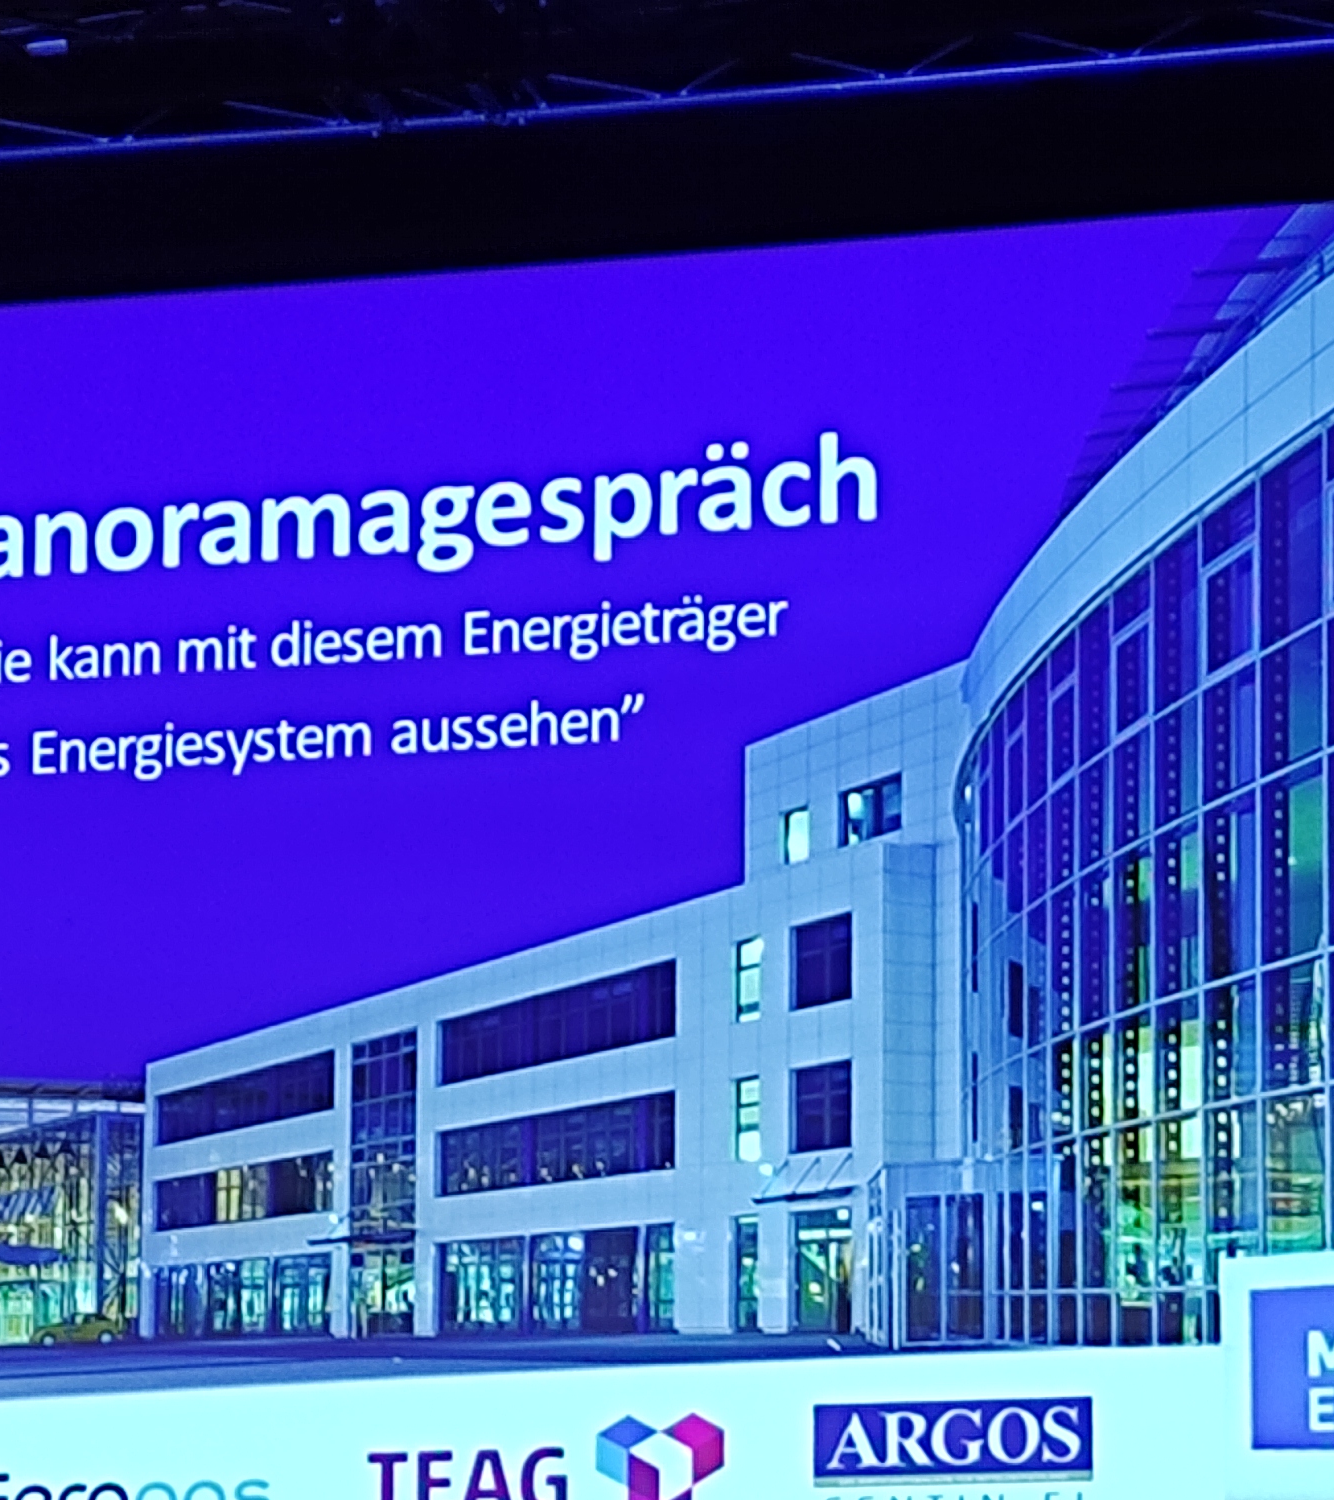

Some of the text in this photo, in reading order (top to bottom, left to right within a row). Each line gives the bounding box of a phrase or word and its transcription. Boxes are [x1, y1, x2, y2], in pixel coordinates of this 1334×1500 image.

[50, 635, 160, 680] kann
[179, 626, 256, 672] mit
[271, 620, 441, 667] diesem
[465, 595, 788, 660] Energieträger
[33, 720, 371, 778] Energiesystem
[827, 1406, 1081, 1469] ARGOS
